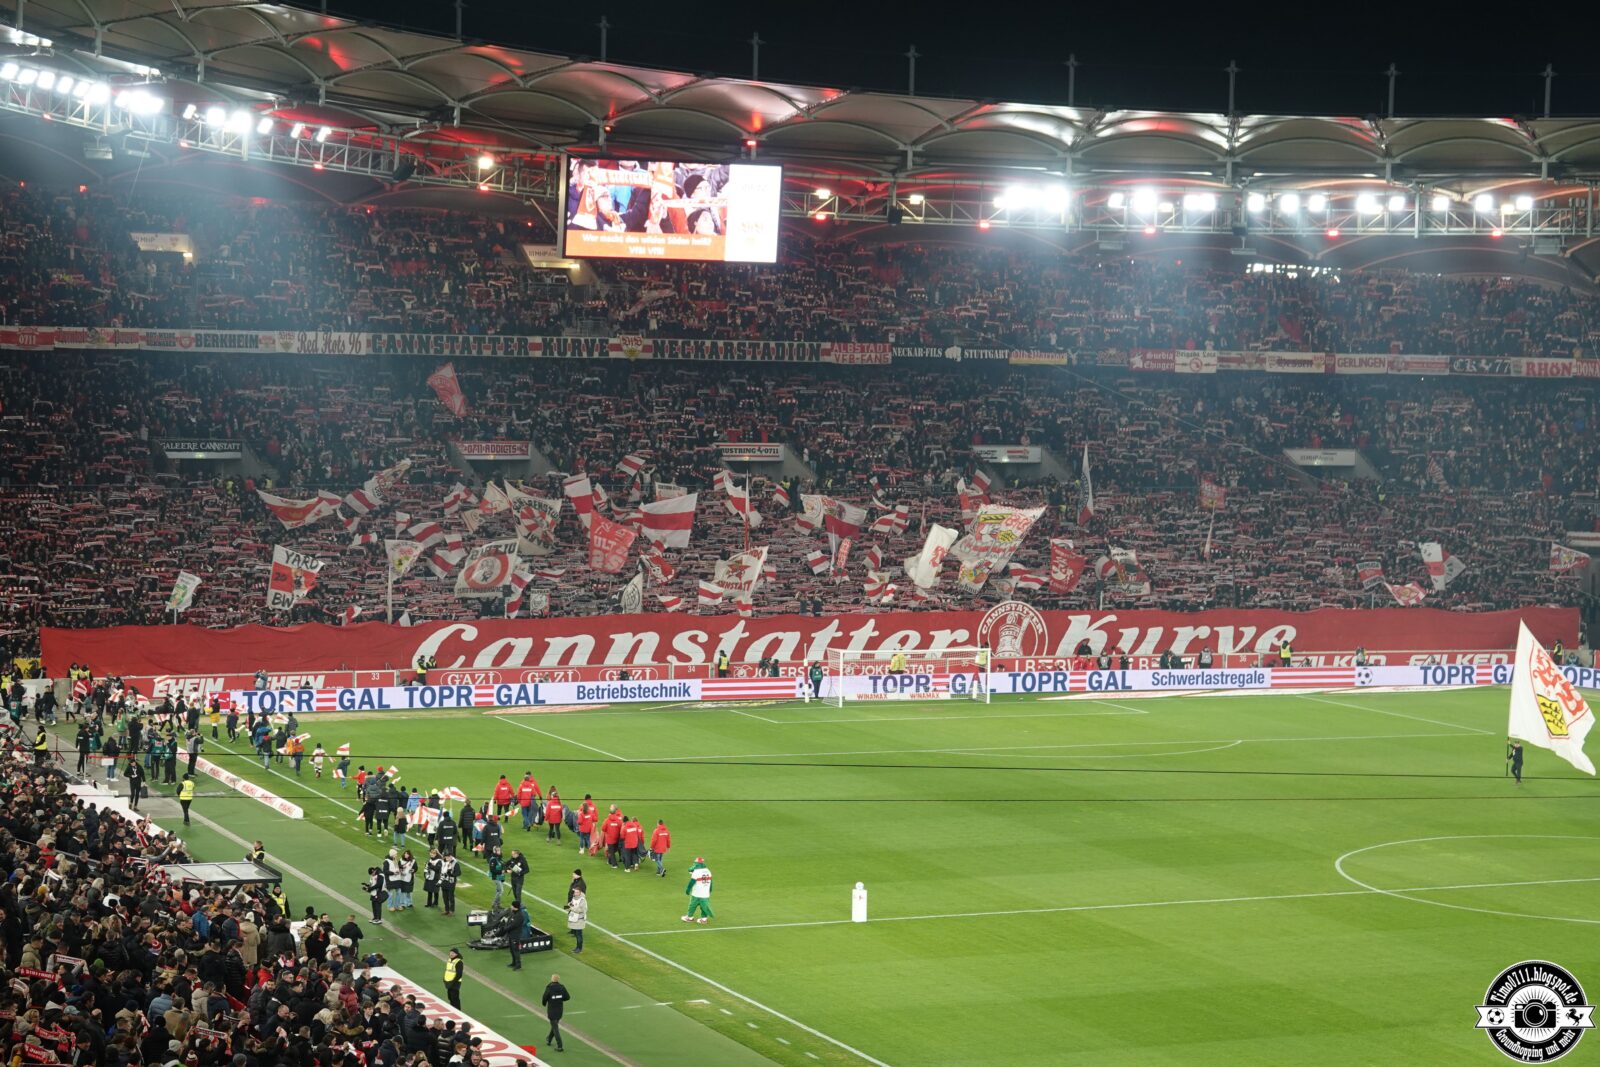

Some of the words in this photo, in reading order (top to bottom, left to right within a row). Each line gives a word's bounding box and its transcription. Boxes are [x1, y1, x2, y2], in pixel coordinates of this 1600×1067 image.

[18, 335, 37, 345] 0711
[195, 333, 259, 348] BERKHEIM
[297, 331, 318, 353] Red
[371, 334, 529, 355] CANNSTATTER
[541, 337, 610, 358] KURVE
[832, 342, 891, 353] ALBSTADT
[652, 339, 822, 362] NECKARSTADION
[834, 353, 891, 364] VFB-FANS
[892, 346, 943, 357] NECKAR-FILS
[963, 349, 1009, 359] STUTTGART
[1337, 357, 1386, 368] GERLINGEN
[200, 442, 240, 450] CANNSTATT
[284, 550, 320, 570] YARD
[981, 603, 1044, 635] CANNSTATTER
[411, 618, 969, 671] Cannstatter
[1055, 614, 1297, 656] Kurve
[371, 672, 380, 681] 33
[687, 665, 696, 673] 34
[1008, 671, 1133, 692] TOPREGAL
[1151, 670, 1265, 688] Schwerlastregale
[404, 683, 546, 708] TOPREGAL
[576, 682, 691, 701] Betriebstechnik
